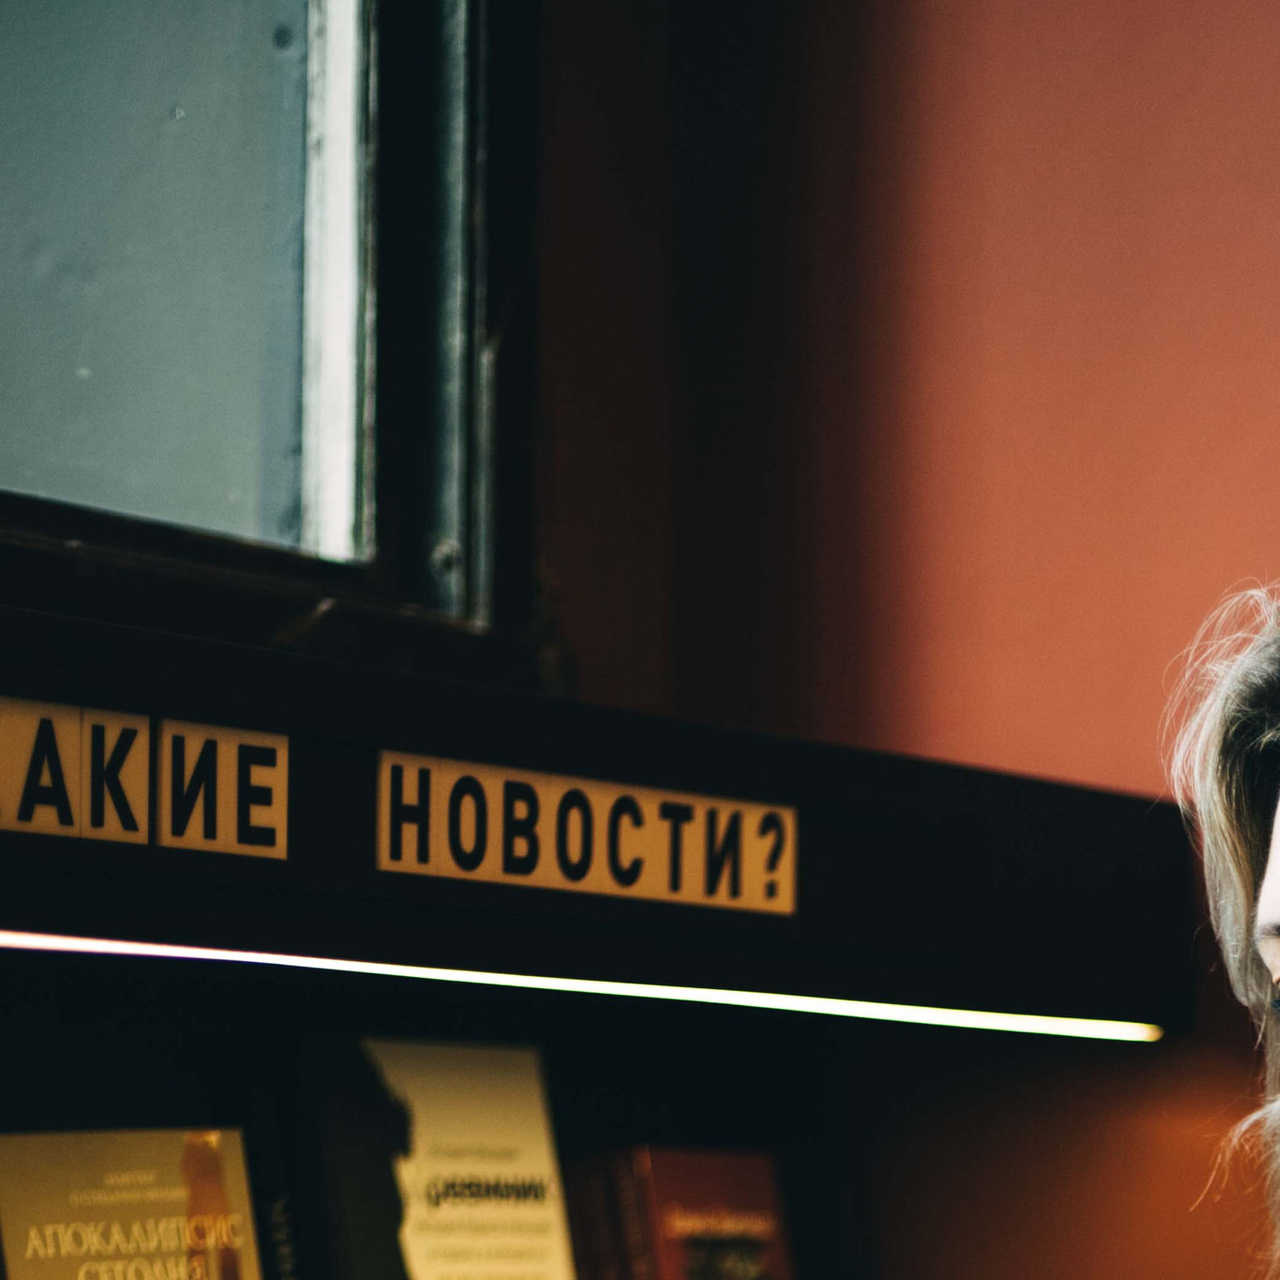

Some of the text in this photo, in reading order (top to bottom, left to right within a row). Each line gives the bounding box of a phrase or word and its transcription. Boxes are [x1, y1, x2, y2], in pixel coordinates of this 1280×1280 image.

[17, 717, 787, 901] АКИЕ НОВОСТИ?
[24, 1212, 245, 1261] АПОКАЛИПСИС
